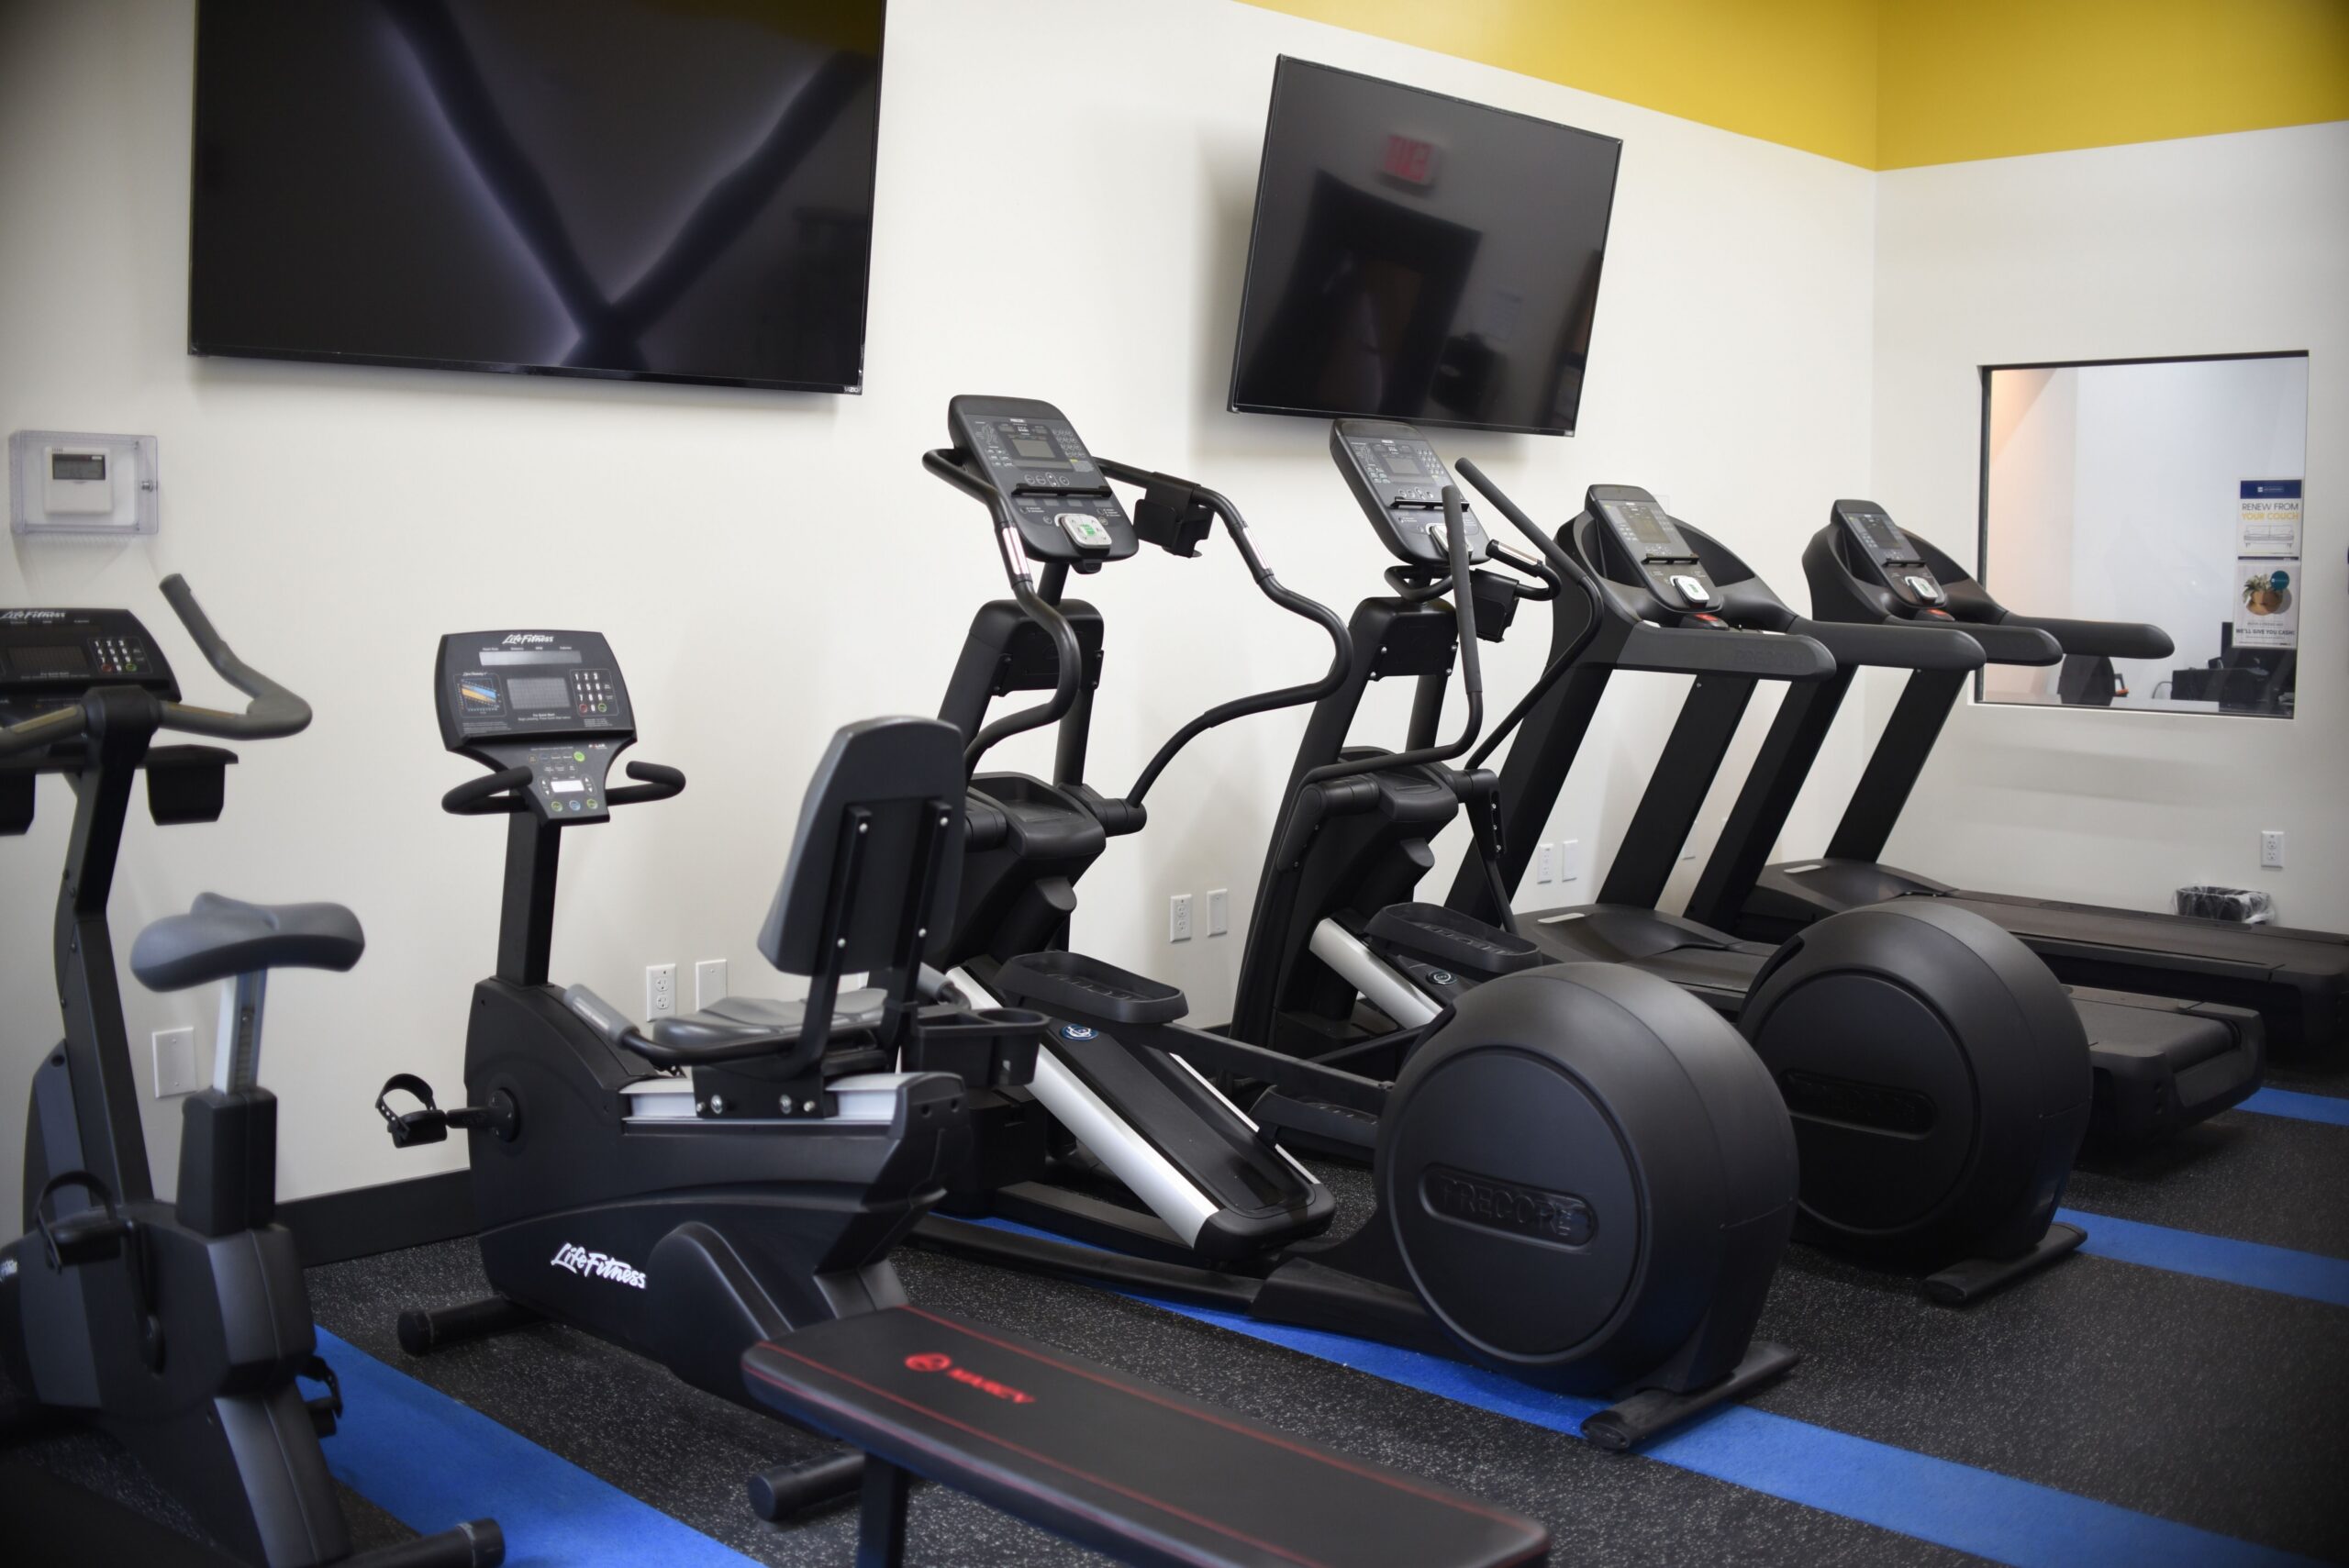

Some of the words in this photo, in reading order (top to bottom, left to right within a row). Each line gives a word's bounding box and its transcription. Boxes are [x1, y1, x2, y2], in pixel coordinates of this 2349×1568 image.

[2242, 502, 2272, 510] RENEW
[2274, 502, 2299, 510] FROM
[2242, 512, 2266, 520] YOUR
[1439, 1175, 1558, 1235] PRECOR
